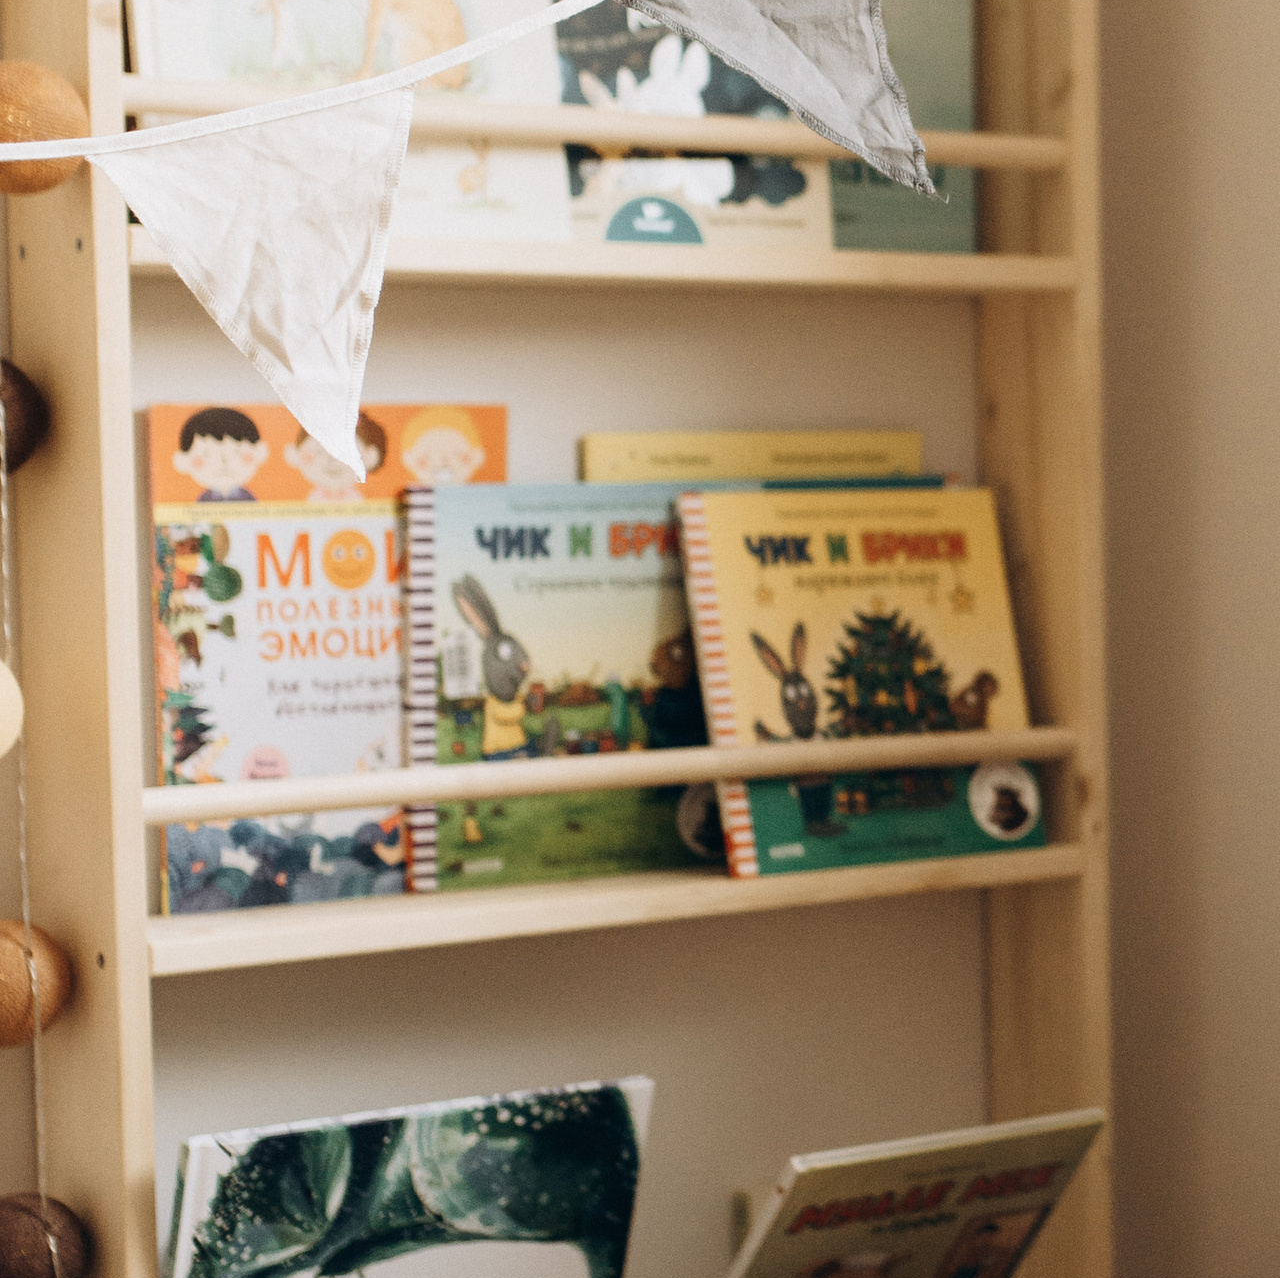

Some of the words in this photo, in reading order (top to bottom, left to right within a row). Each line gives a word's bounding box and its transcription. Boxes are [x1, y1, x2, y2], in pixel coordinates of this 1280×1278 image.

[475, 523, 552, 561] ЧИК
[567, 522, 593, 558] И
[608, 520, 681, 559] БРИ
[743, 531, 813, 566] ЧИК
[825, 532, 849, 564] И
[861, 528, 966, 564] БРИКИ
[260, 627, 402, 661] ЭМОЦИ
